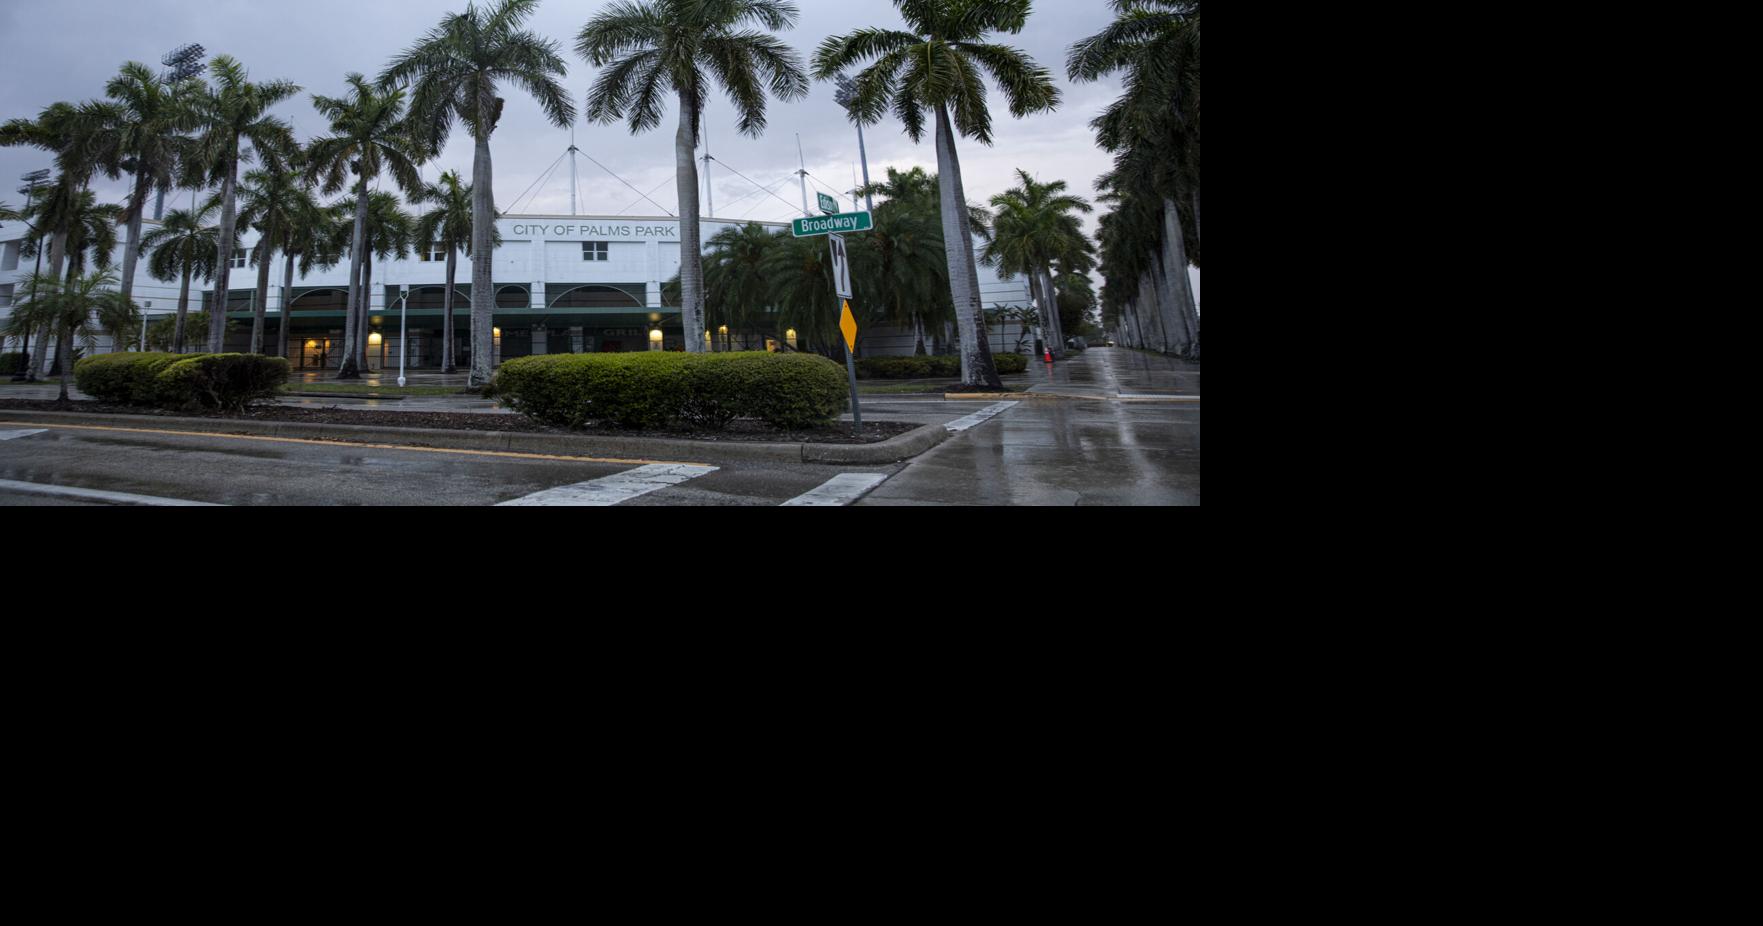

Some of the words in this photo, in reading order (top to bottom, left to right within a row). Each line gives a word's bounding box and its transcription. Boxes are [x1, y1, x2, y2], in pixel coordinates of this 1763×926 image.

[513, 224, 549, 236] CITY
[553, 224, 575, 236] OF
[580, 225, 631, 237] PALMS
[635, 226, 675, 237] PARK
[801, 216, 858, 232] Broadway
